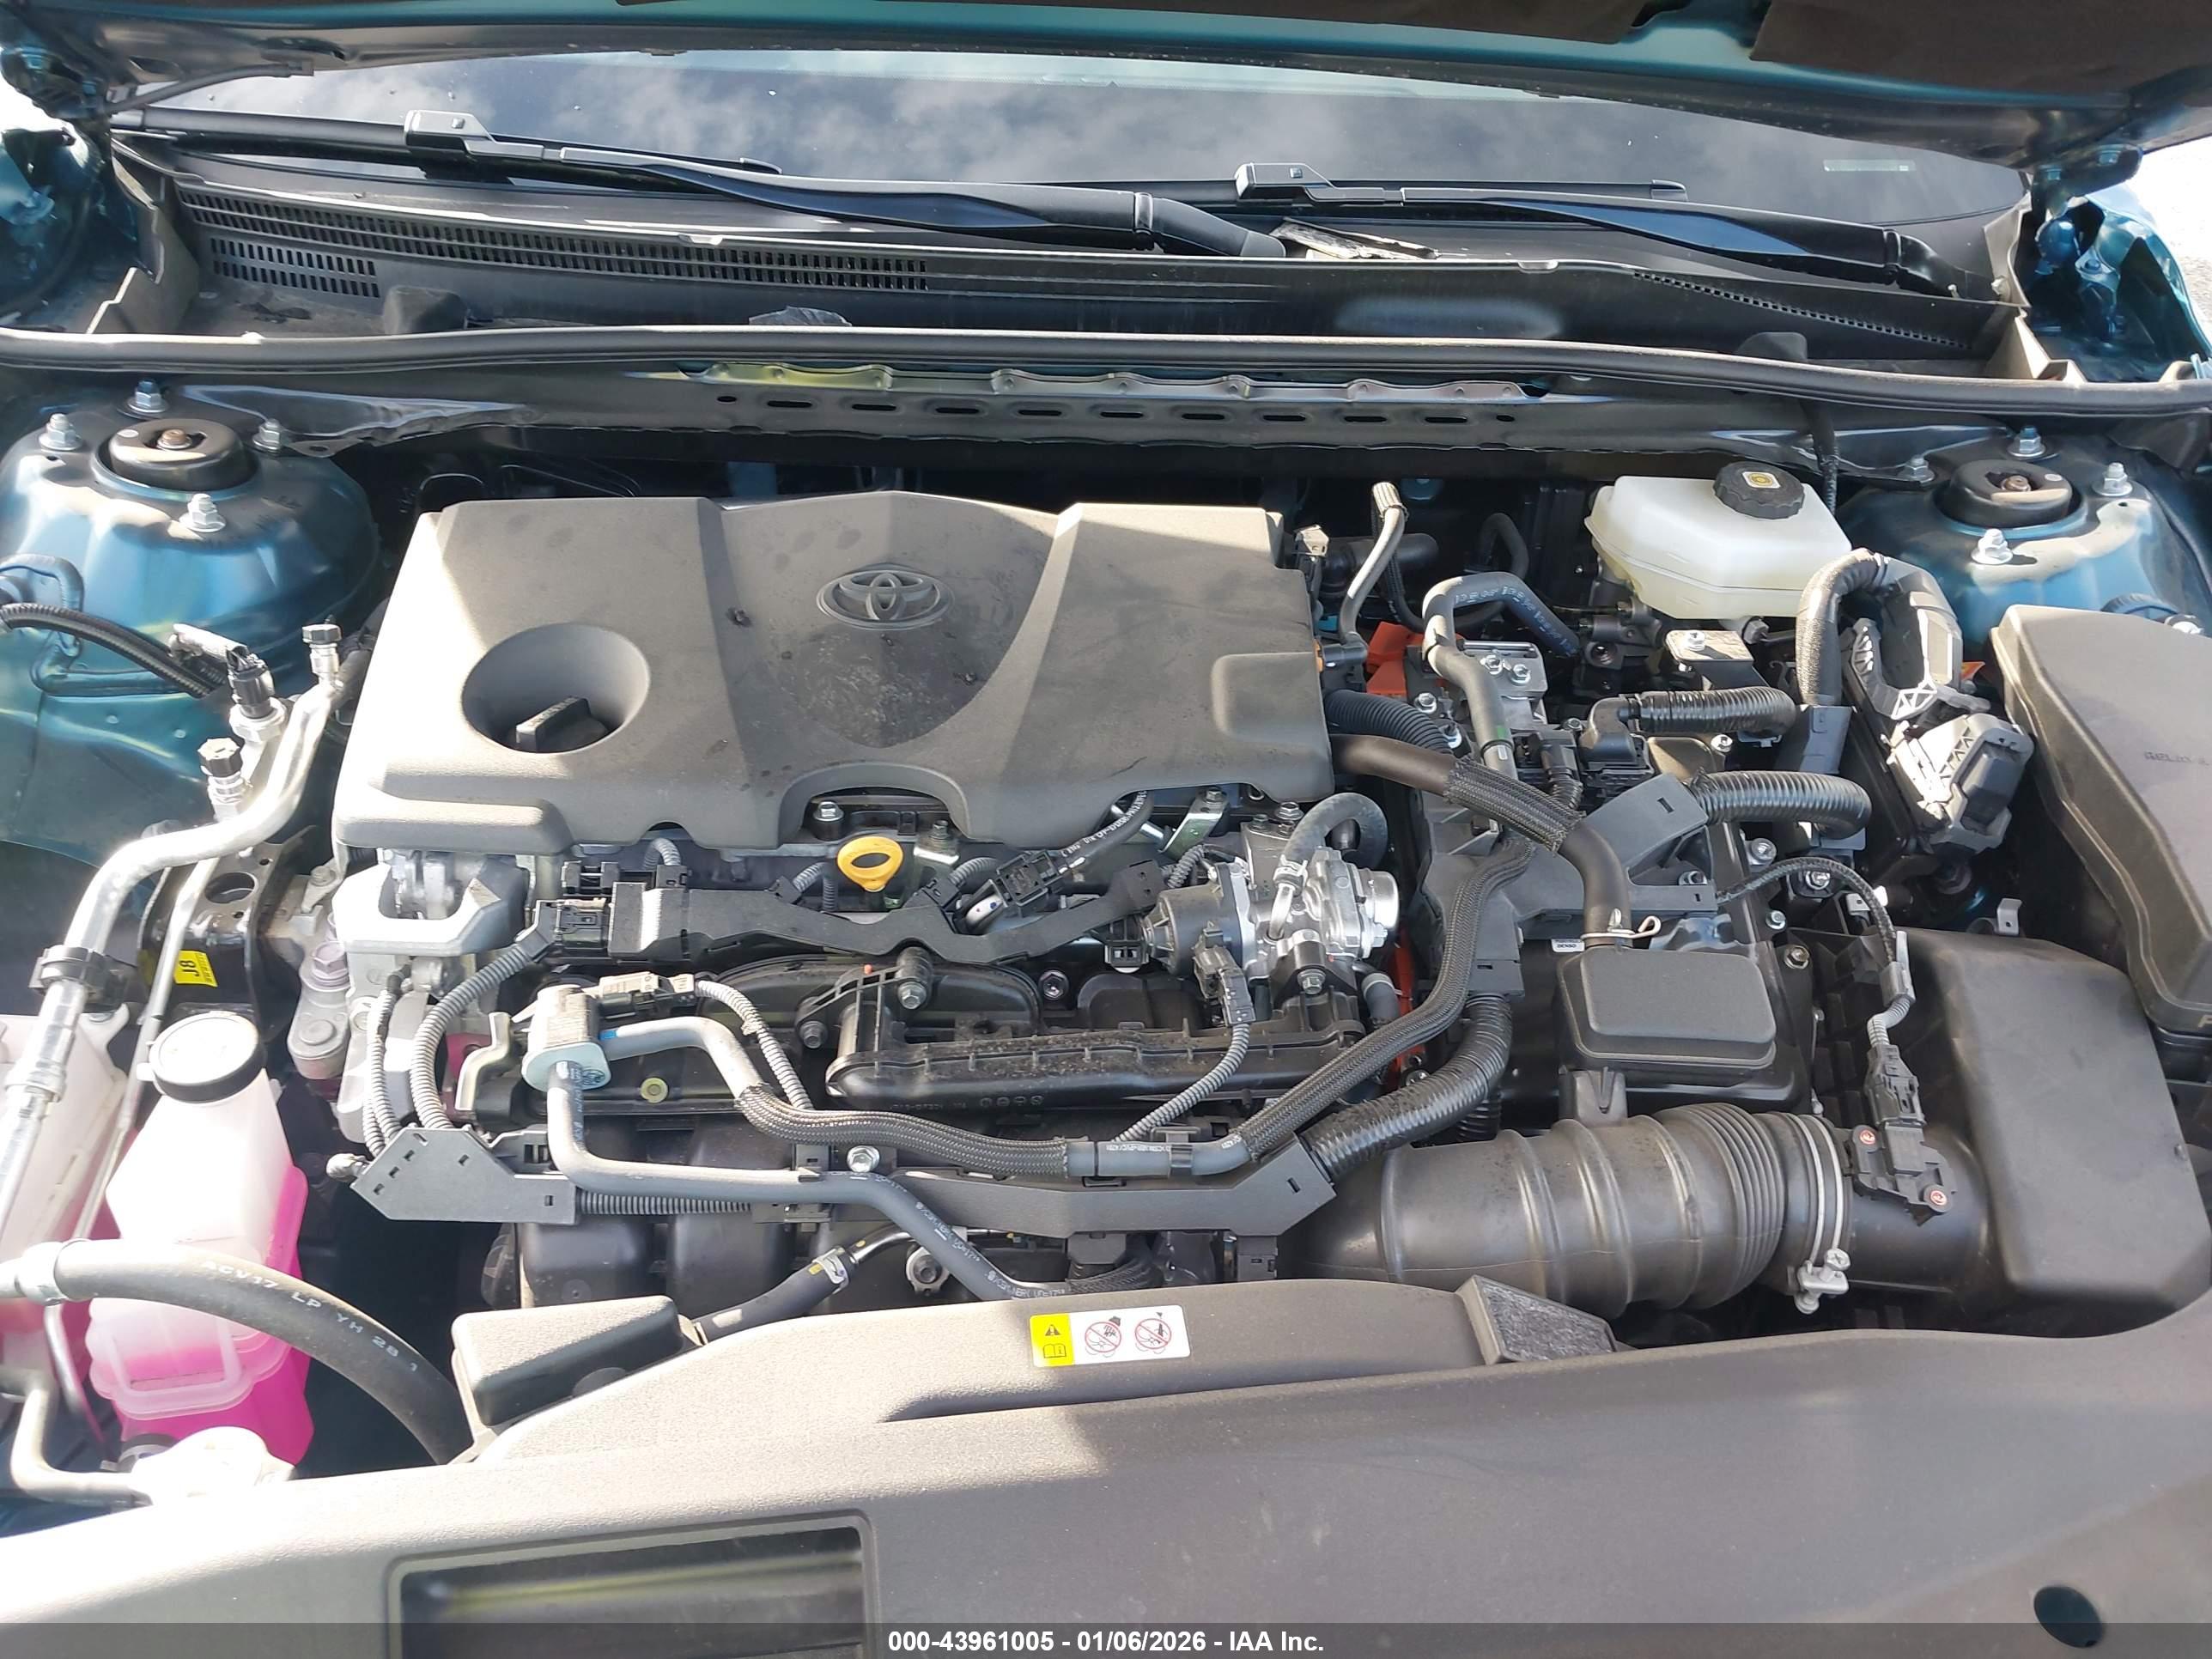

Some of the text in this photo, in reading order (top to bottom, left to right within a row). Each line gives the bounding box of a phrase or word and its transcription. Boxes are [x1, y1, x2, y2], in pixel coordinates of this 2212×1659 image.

[178, 960, 200, 977] J8
[290, 1291, 323, 1309] LP
[336, 1312, 364, 1334] YH
